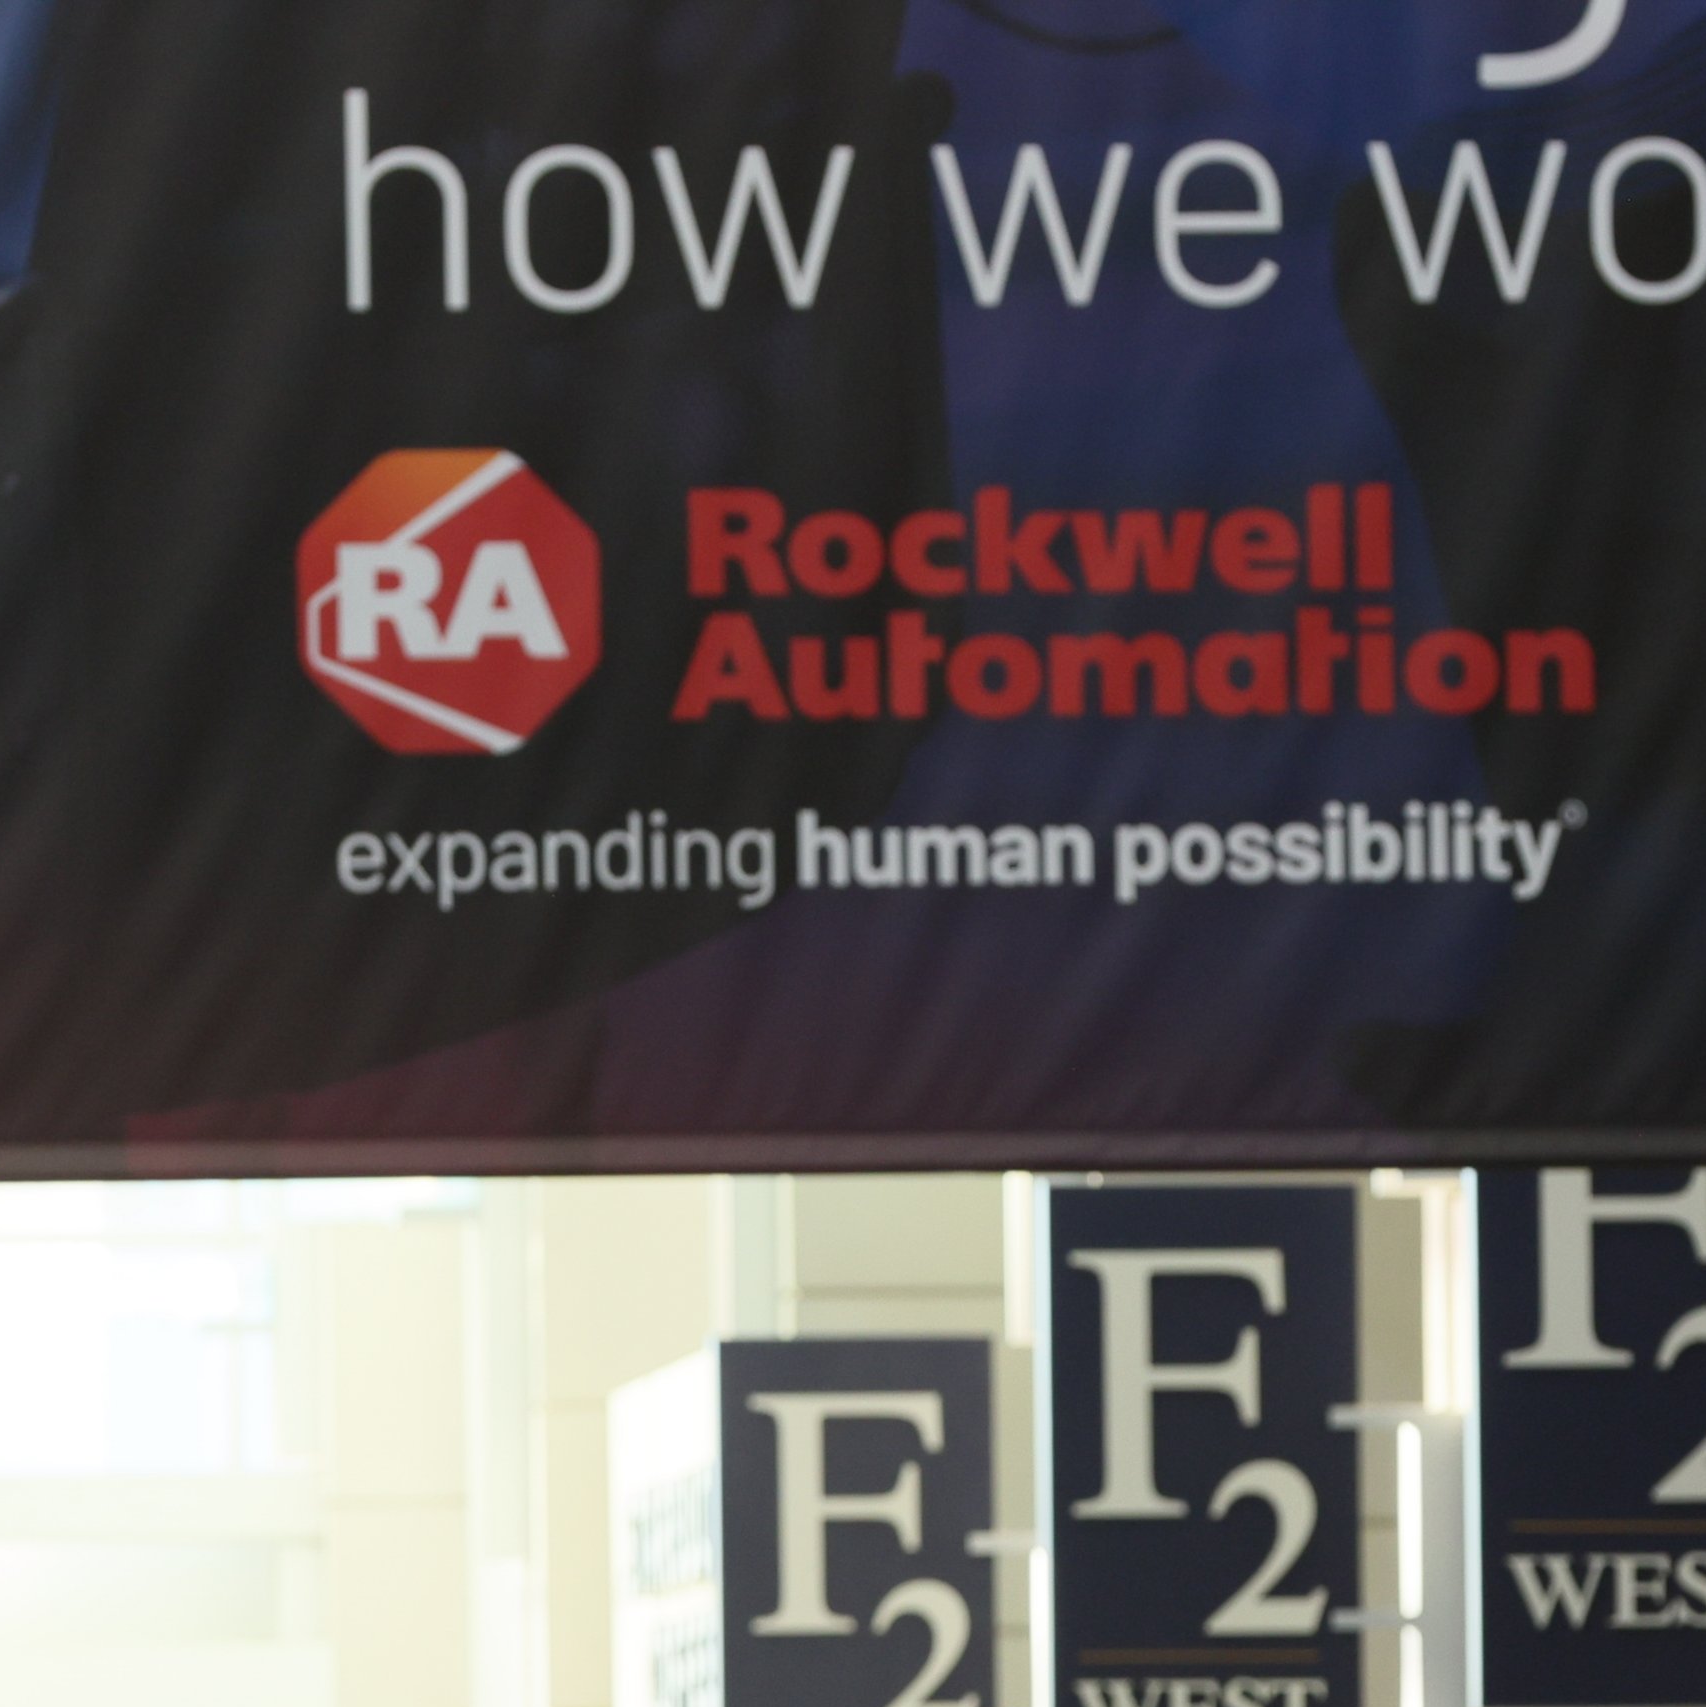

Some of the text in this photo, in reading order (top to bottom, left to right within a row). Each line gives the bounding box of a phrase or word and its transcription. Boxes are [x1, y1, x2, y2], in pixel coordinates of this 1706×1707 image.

[343, 87, 855, 312] how
[931, 139, 1284, 308] we
[687, 484, 1391, 597] Rockwell
[335, 539, 570, 662] RA
[674, 611, 1594, 722] Automation
[336, 809, 776, 911] expanding
[796, 808, 1096, 889] human
